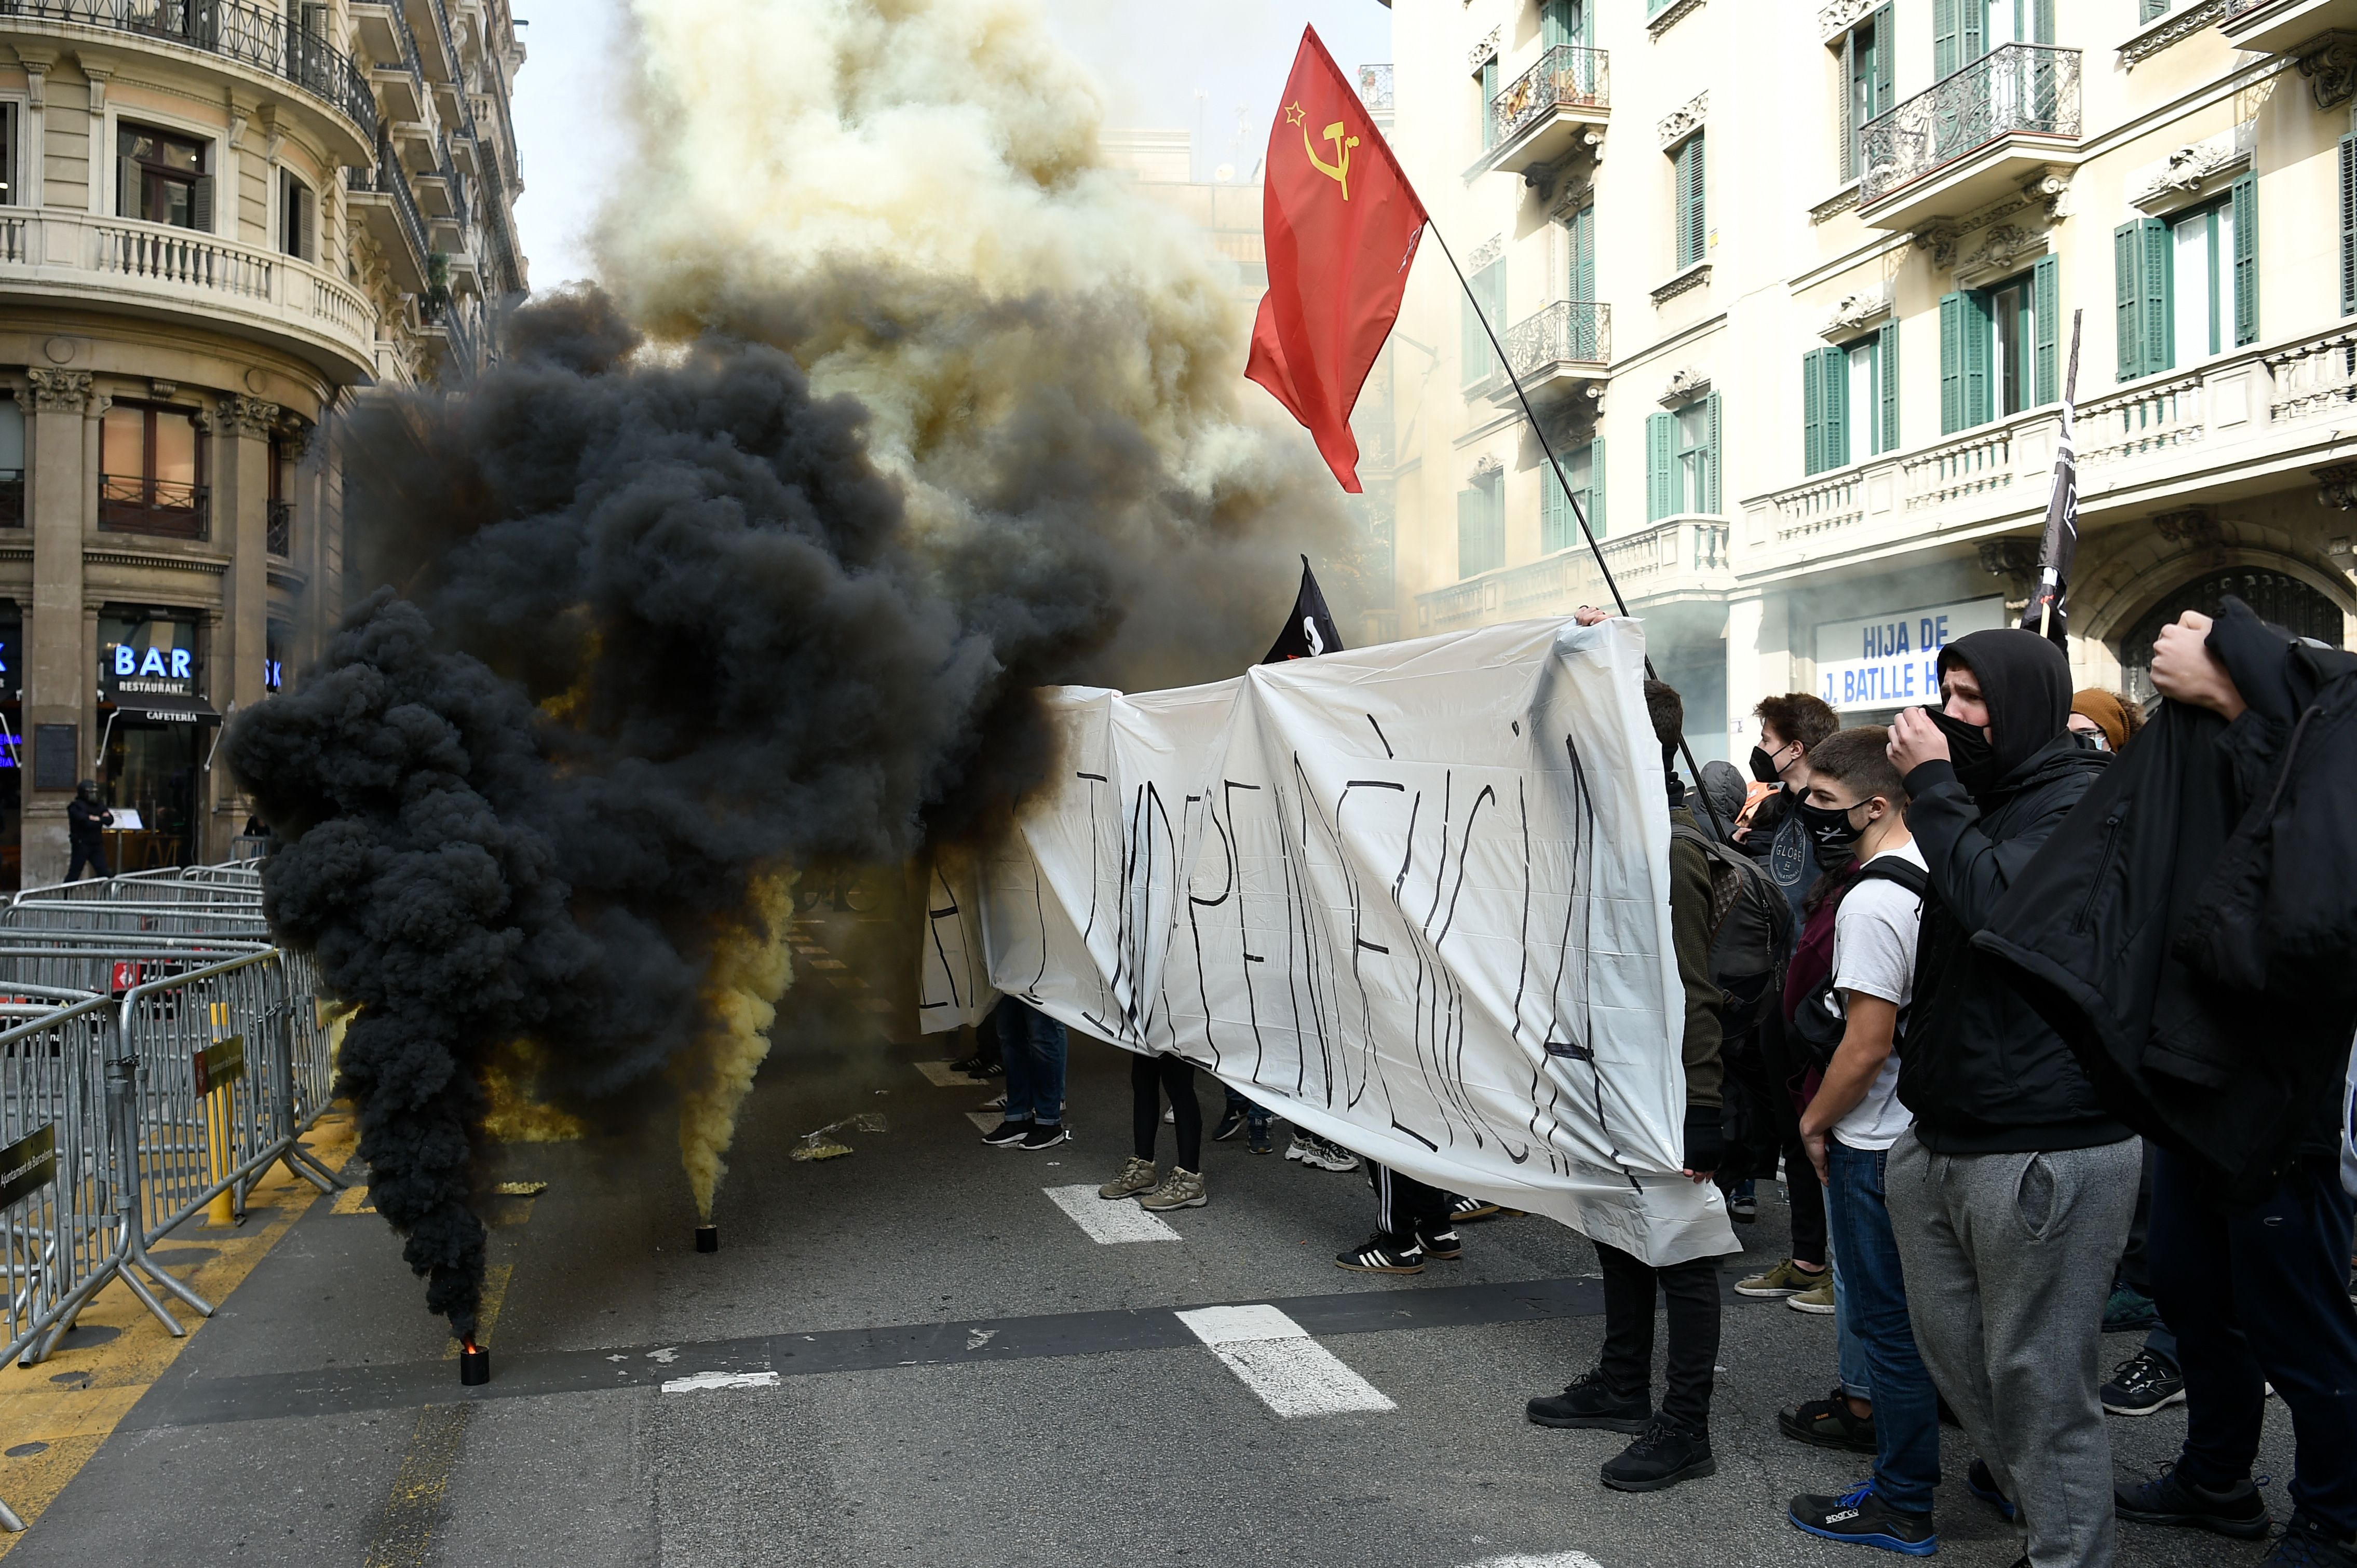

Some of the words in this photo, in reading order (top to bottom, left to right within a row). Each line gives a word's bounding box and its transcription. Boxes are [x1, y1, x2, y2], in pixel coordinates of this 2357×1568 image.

[1863, 622, 1909, 660] HIJA
[1921, 616, 1948, 652] DE
[115, 646, 191, 678] BAR
[119, 681, 183, 693] RESTAURANT
[1823, 673, 1837, 704] J.
[1845, 663, 1914, 703] BATLLE
[1776, 845, 1801, 862] GLOBE
[1, 1162, 26, 1189] Ajuntament
[27, 1158, 32, 1170] de
[32, 1148, 52, 1168] Barcelona
